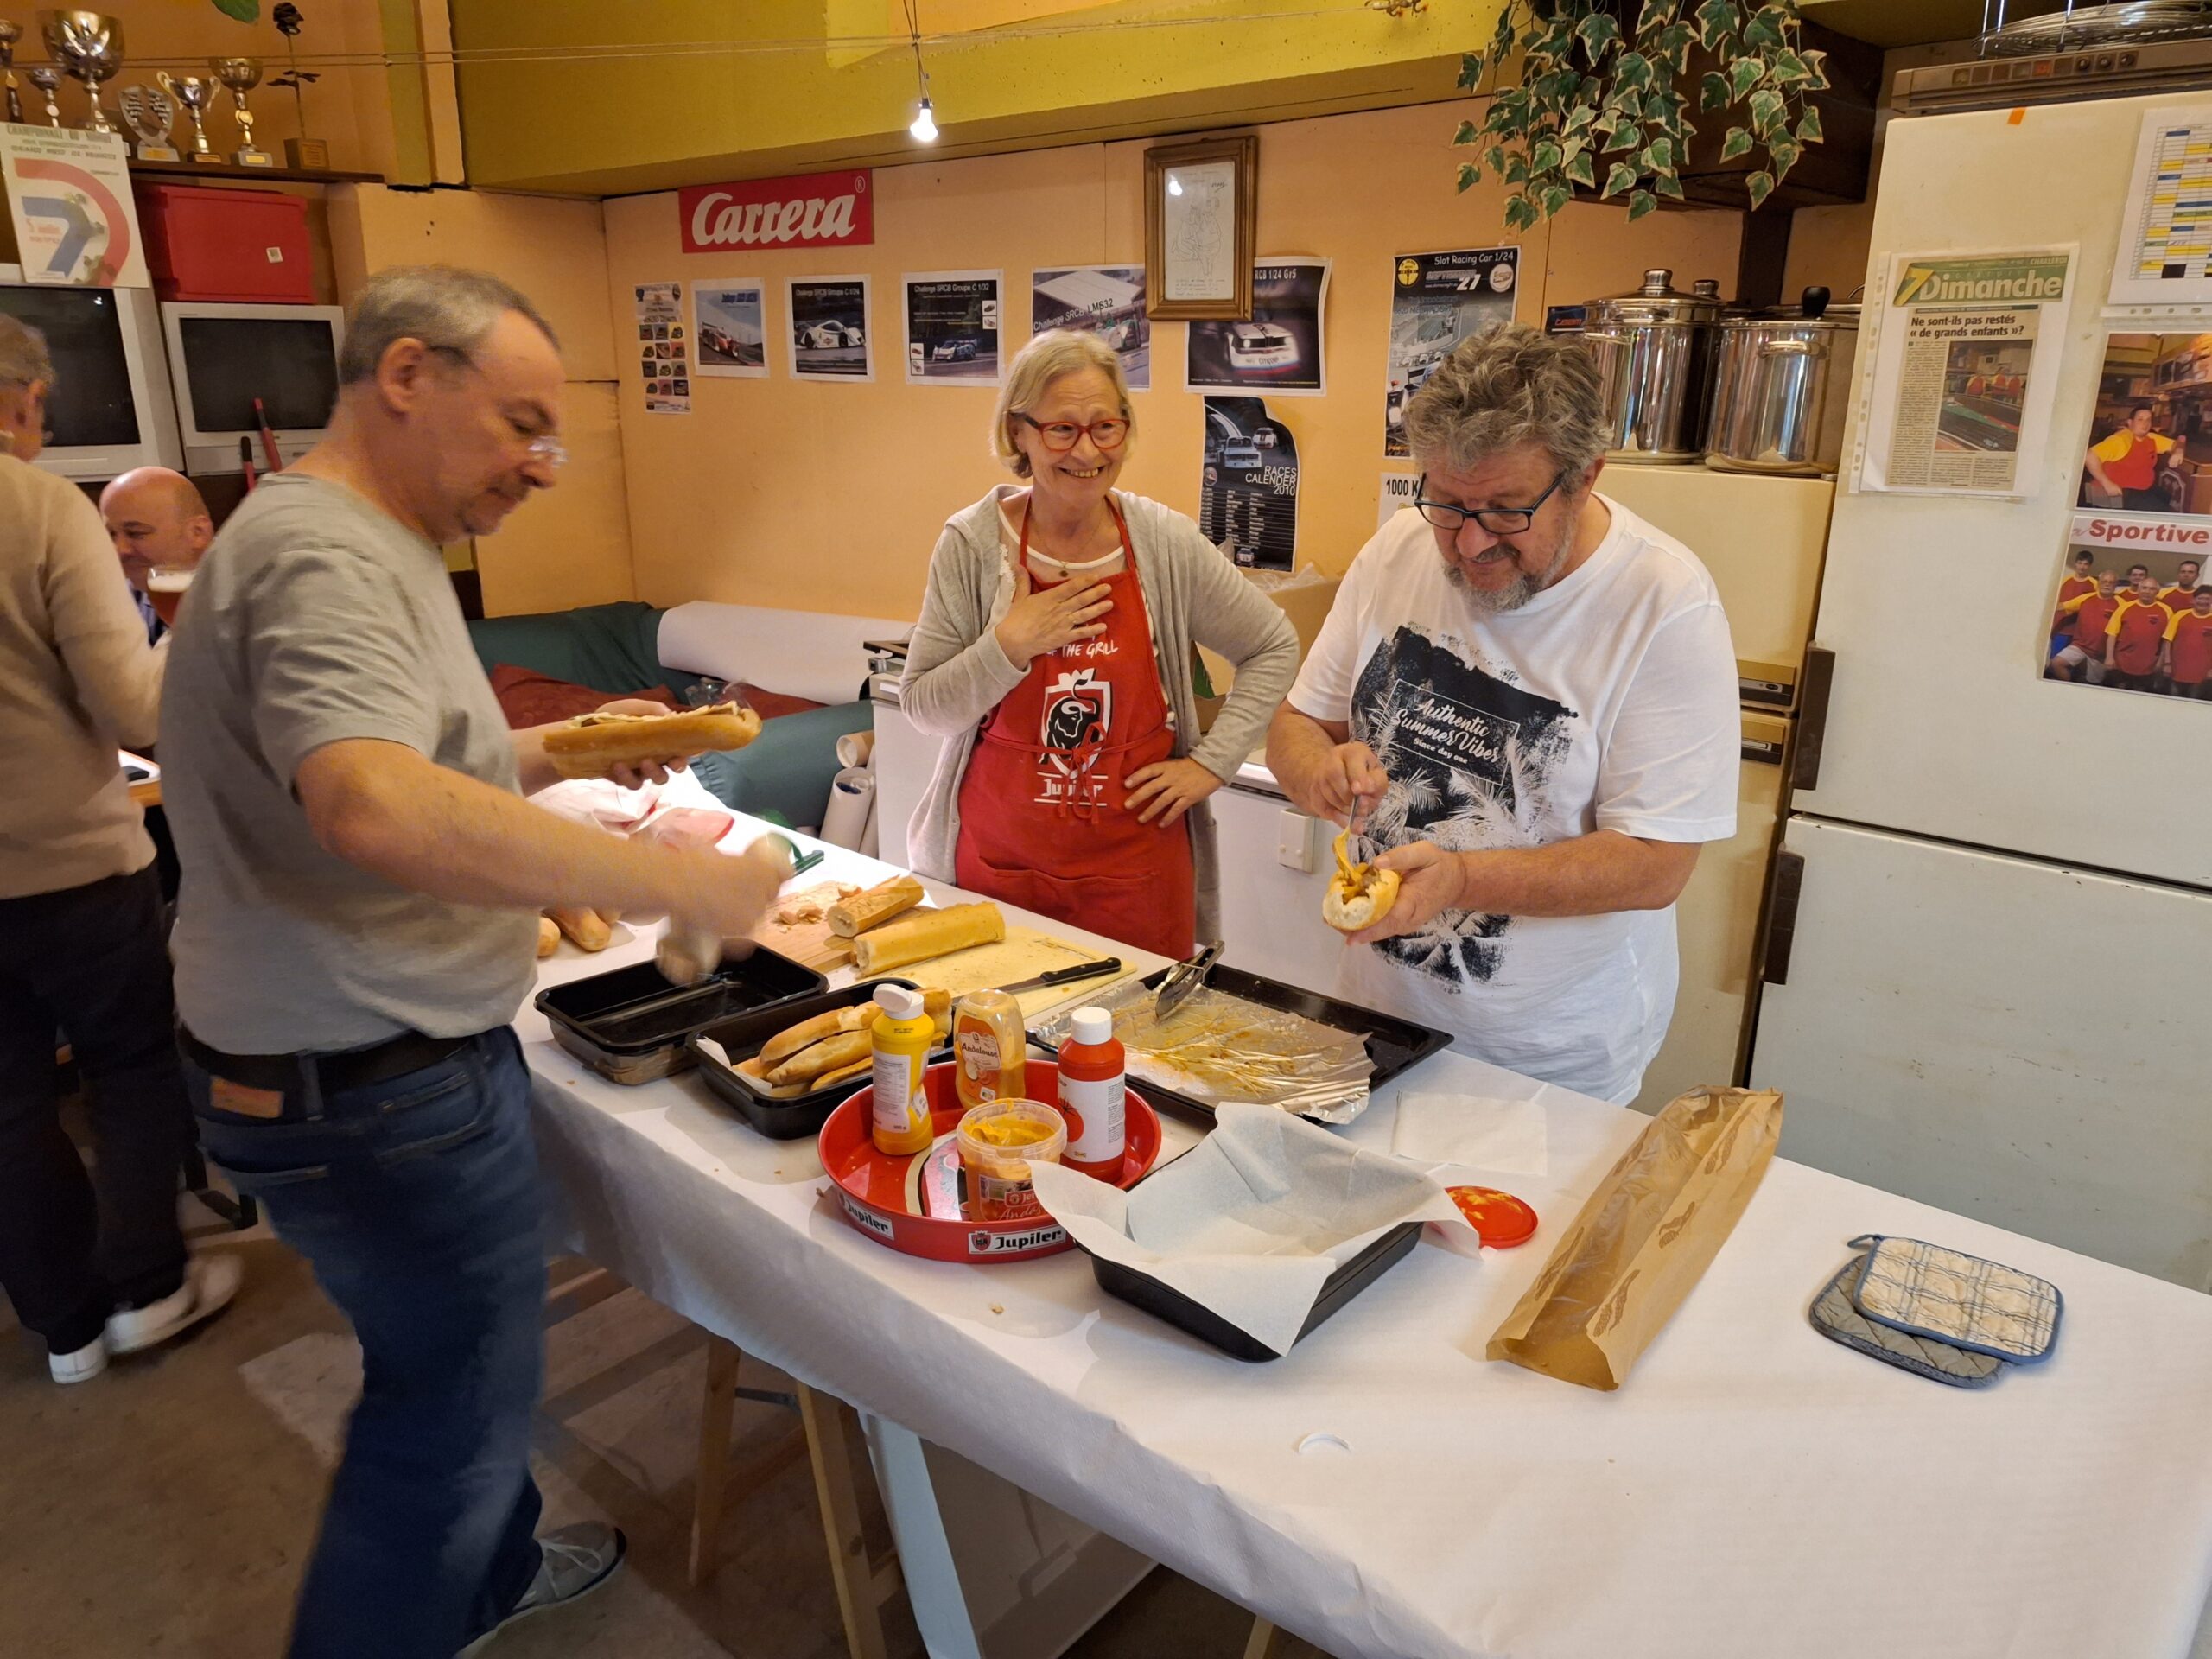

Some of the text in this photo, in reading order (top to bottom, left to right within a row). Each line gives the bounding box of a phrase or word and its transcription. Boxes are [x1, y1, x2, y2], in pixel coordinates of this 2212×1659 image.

[692, 192, 855, 245] Carrera
[1434, 251, 1514, 266] Slot Racing Car 1/24
[1268, 269, 1282, 280] 1/24
[1284, 268, 1297, 280] Gr5
[1919, 270, 2063, 301] Dimanche
[1033, 315, 1064, 331] Challenge
[1087, 298, 1114, 314] LMS32
[1911, 314, 2016, 328] Ne sont-ils pas restés
[1919, 327, 1933, 338] de
[1935, 327, 1967, 340] grands
[1971, 326, 2008, 337] enfants
[1245, 473, 1296, 486] CALENDER
[1264, 466, 1297, 477] RACES
[1274, 486, 1295, 496] 2010
[1386, 478, 1408, 496] 1000
[2089, 519, 2209, 544] Sportive
[1062, 644, 1084, 658] THE
[1086, 639, 1119, 659] GRILL
[1413, 698, 1490, 737] Authentic
[1390, 709, 1500, 763] Summer Vibes
[1413, 738, 1468, 765] Since day one
[962, 1042, 998, 1058] Andalouse
[845, 1199, 889, 1232] Jupiler
[995, 1230, 1062, 1249] Jupiler
